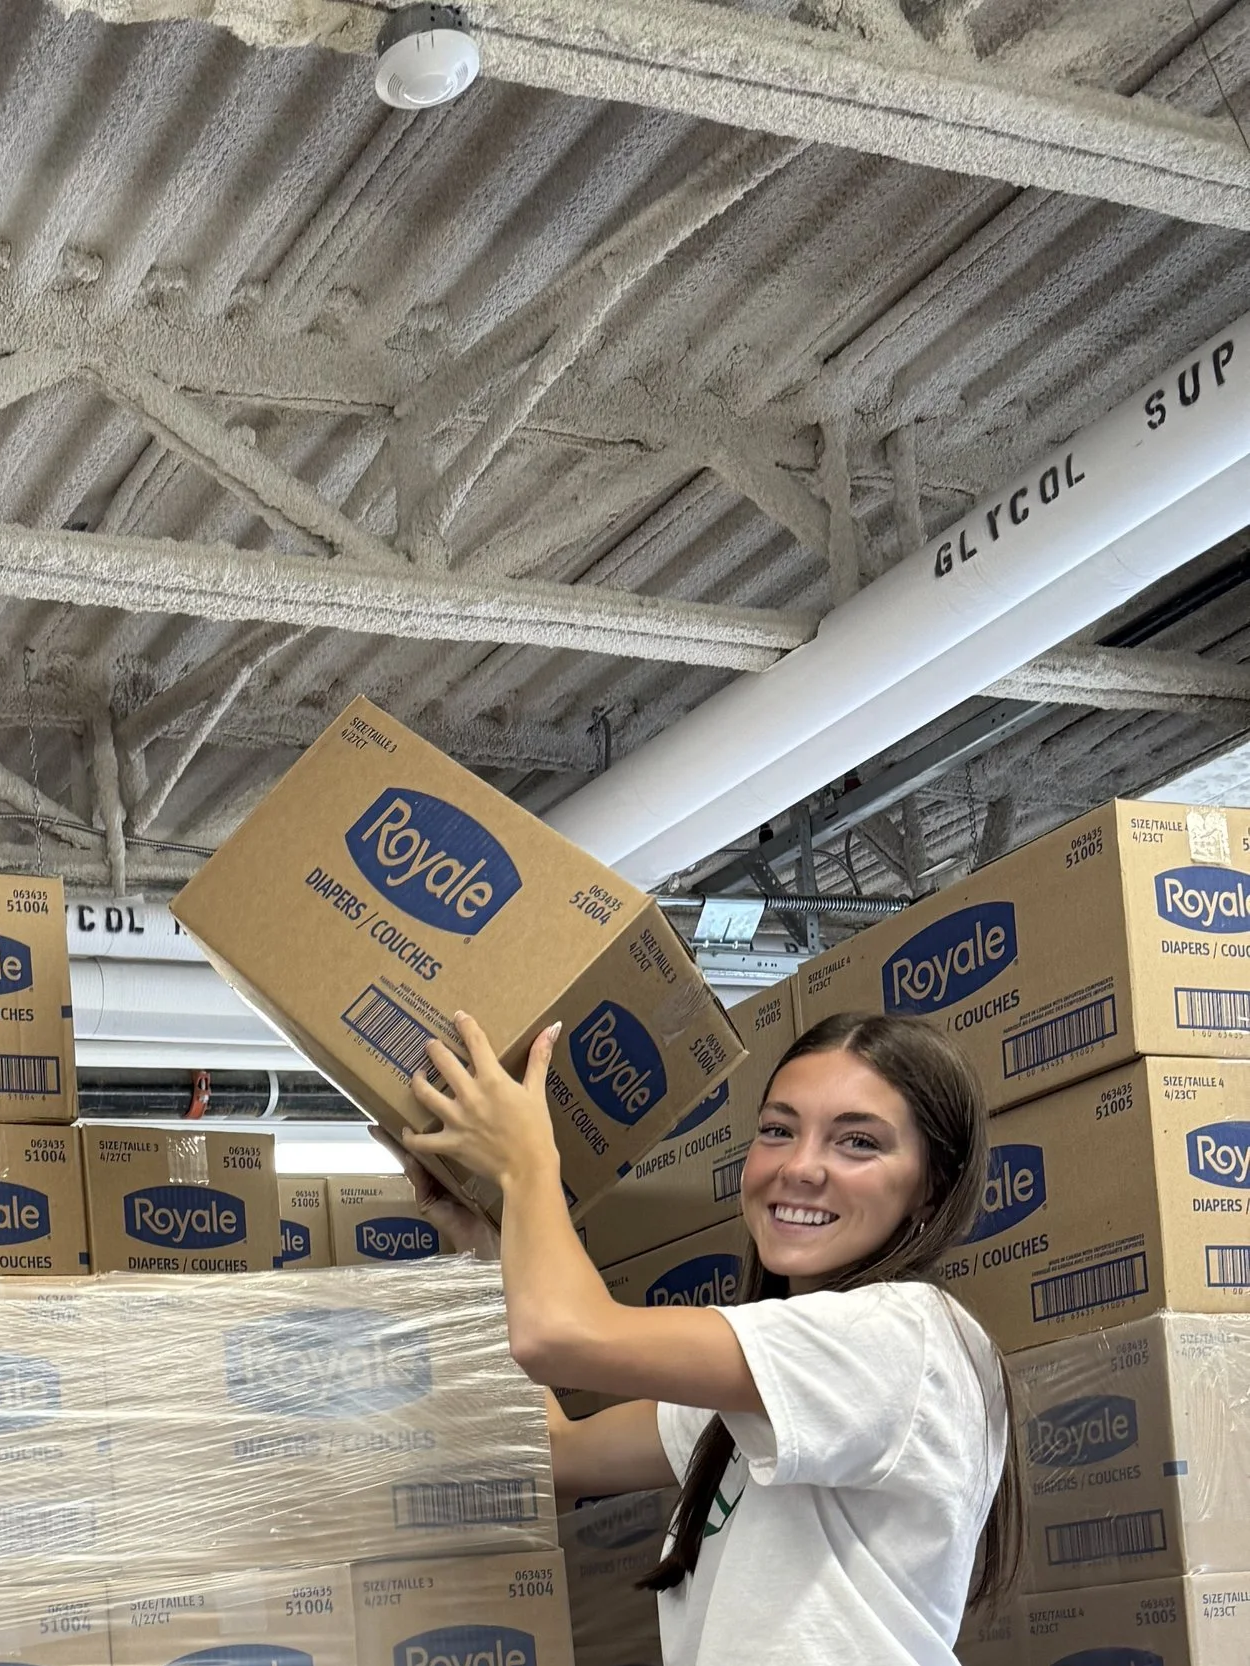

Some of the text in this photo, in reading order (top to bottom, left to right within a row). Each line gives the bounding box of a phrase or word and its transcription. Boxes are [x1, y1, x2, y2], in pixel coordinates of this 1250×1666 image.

[934, 453, 1085, 578] GLYCOL
[341, 725, 368, 752] 4/27CT
[349, 716, 391, 751] SIZE/TAILLE
[1131, 818, 1182, 831] SIZE/TAILLE
[1071, 826, 1103, 850] 063435
[1132, 832, 1163, 842] 4/23CT
[361, 798, 494, 920] Royale
[1065, 837, 1104, 869] 51005
[6, 899, 49, 915] 51004
[12, 889, 48, 901] 063435
[588, 883, 623, 912] 063435
[65, 905, 144, 933] COL
[568, 890, 612, 927] 51004
[304, 866, 443, 982] DIAPERS COUCHES
[1162, 940, 1209, 954] DIAPERS
[891, 921, 1006, 1004] Royale
[954, 989, 1021, 1032] COUCHES
[580, 1015, 652, 1114] Royale
[688, 1036, 716, 1076] 51004
[1163, 1076, 1217, 1088] SIZE/TAILLE
[1164, 1090, 1197, 1101] 4/23CT
[1095, 1096, 1133, 1121] 51005
[24, 1148, 66, 1164] 51004
[99, 1140, 151, 1152] SIZE/TAILLE
[99, 1152, 132, 1164] 4/27CT
[636, 1125, 731, 1180] DIAPERS COUCHES
[223, 1156, 262, 1171] 51004
[1193, 1198, 1242, 1212] DIAPERS
[134, 1197, 237, 1242] Royale
[362, 1226, 433, 1255] Royale
[982, 1234, 1049, 1269] COUCHES
[128, 1256, 247, 1272] DIAPERS COUCHES
[515, 1569, 553, 1581] 063435
[508, 1581, 554, 1598] 51004
[285, 1599, 334, 1616] 51004
[1135, 1609, 1176, 1625] 51005
